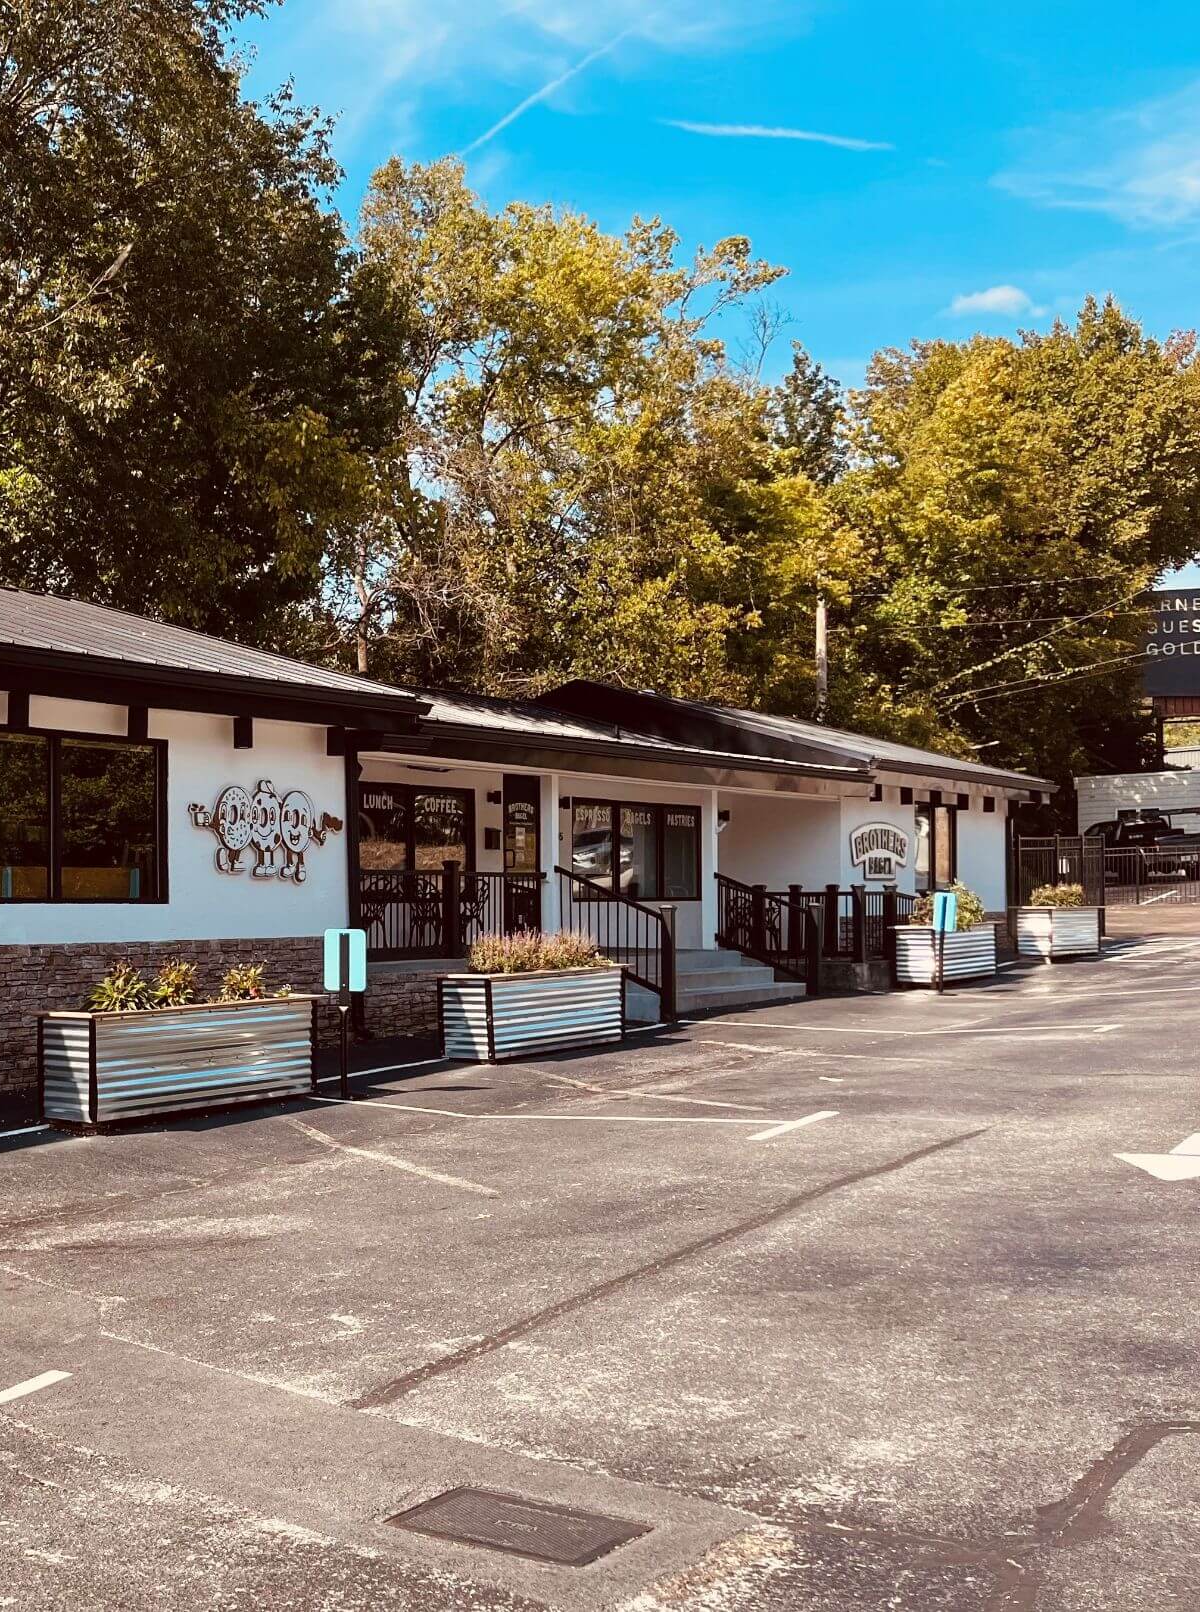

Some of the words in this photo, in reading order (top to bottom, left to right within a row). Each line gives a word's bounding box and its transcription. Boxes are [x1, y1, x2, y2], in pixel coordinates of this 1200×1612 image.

[363, 793, 393, 810] LUNCH
[424, 797, 457, 814] COFFEE
[508, 802, 534, 815] BROTHERS
[575, 807, 611, 823] ESPRESSO
[624, 810, 651, 825] BAGELS
[667, 814, 695, 827] PASTRIES
[854, 828, 906, 859] BROTHERS
[868, 857, 895, 874] BAGEL
